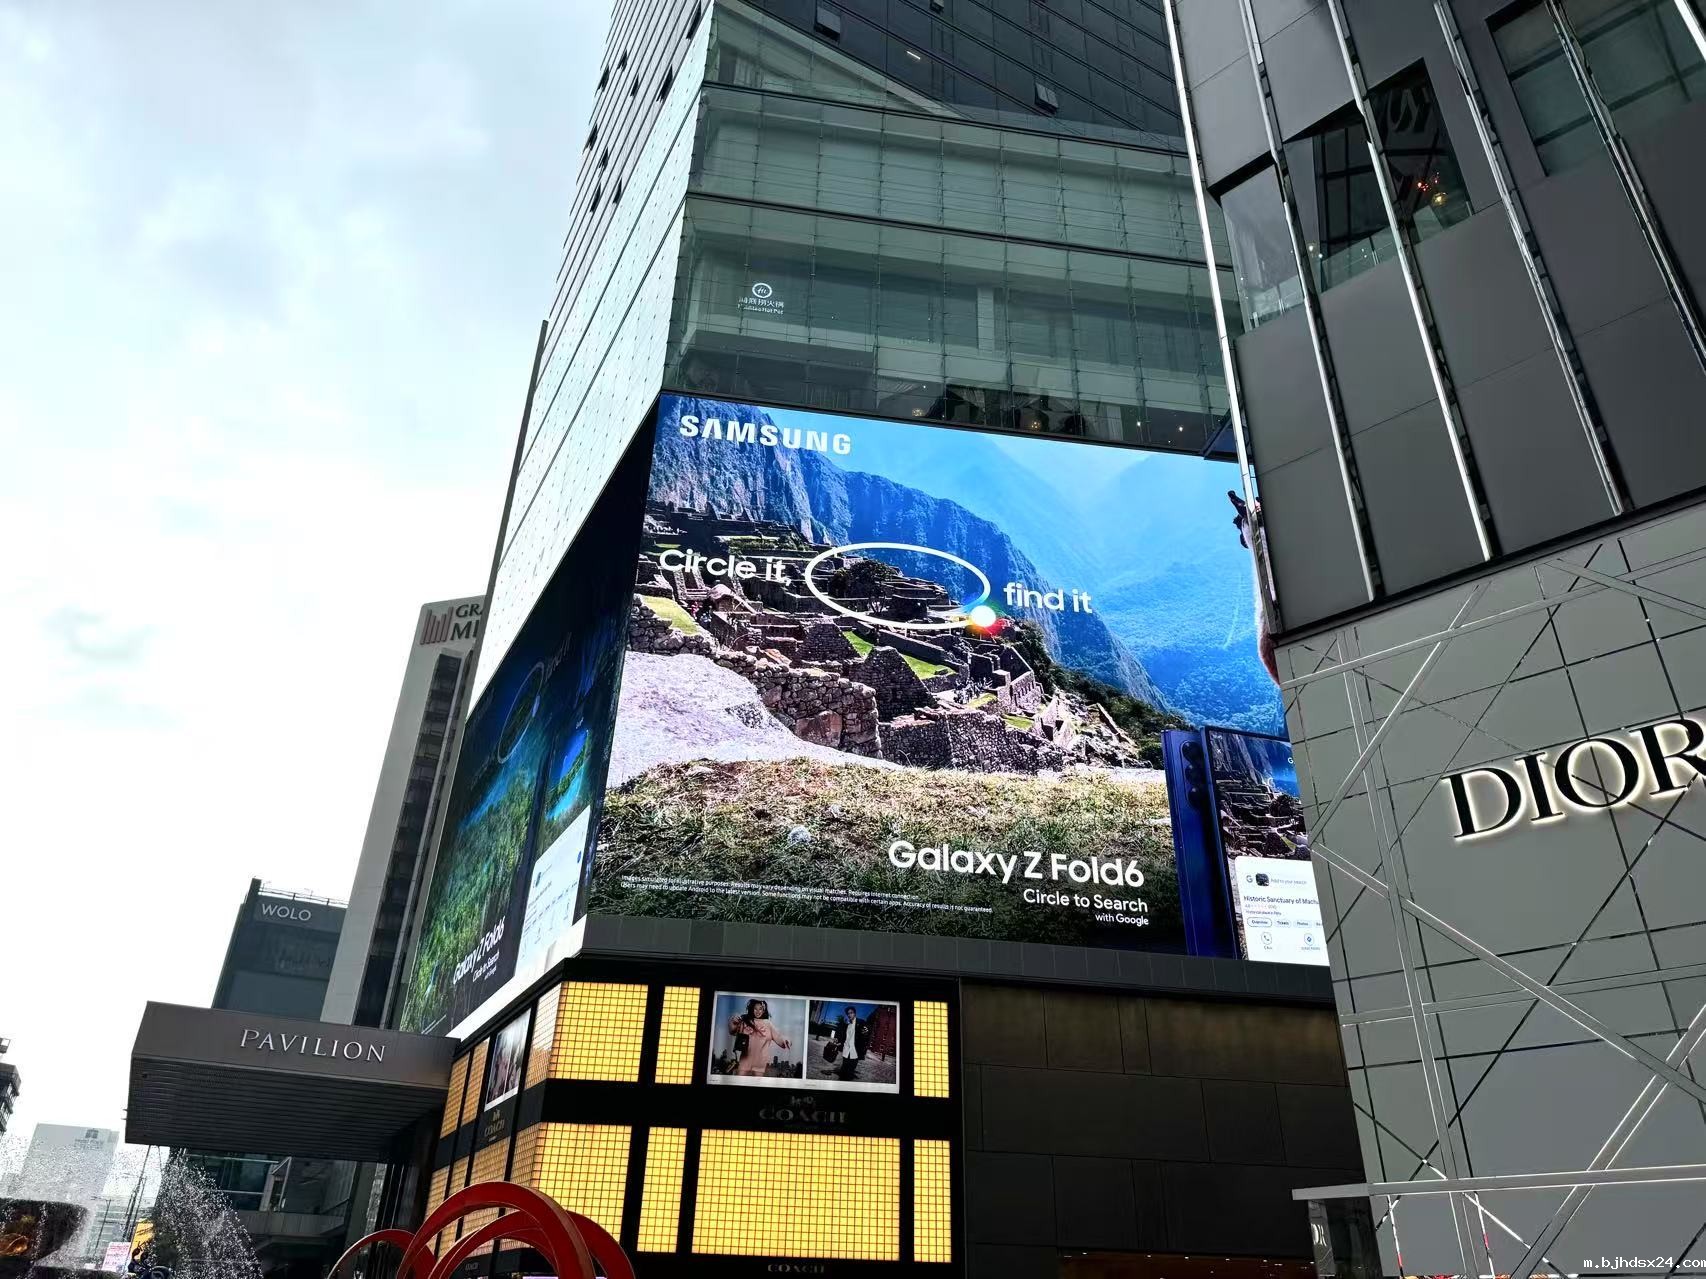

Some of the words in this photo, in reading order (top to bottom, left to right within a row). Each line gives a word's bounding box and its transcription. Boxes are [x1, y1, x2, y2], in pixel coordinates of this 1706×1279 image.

[679, 415, 851, 455] SAMSUNG
[659, 548, 757, 579] Circle
[765, 557, 791, 586] it,
[1003, 582, 1064, 611] find
[1071, 588, 1093, 614] it
[1441, 718, 1706, 838] DIOR
[888, 840, 1017, 884] Galaxy
[1024, 850, 1043, 879] Z
[1050, 852, 1145, 888] Fold6
[262, 903, 311, 921] WOLO
[1023, 888, 1069, 906] Circle
[1073, 894, 1090, 907] to
[1093, 894, 1148, 912] Search
[1244, 895, 1266, 903] Historic
[1267, 897, 1294, 905] Sanctuary
[1095, 913, 1114, 922] with
[1115, 913, 1149, 927] Google
[240, 1028, 386, 1062] PAVILION
